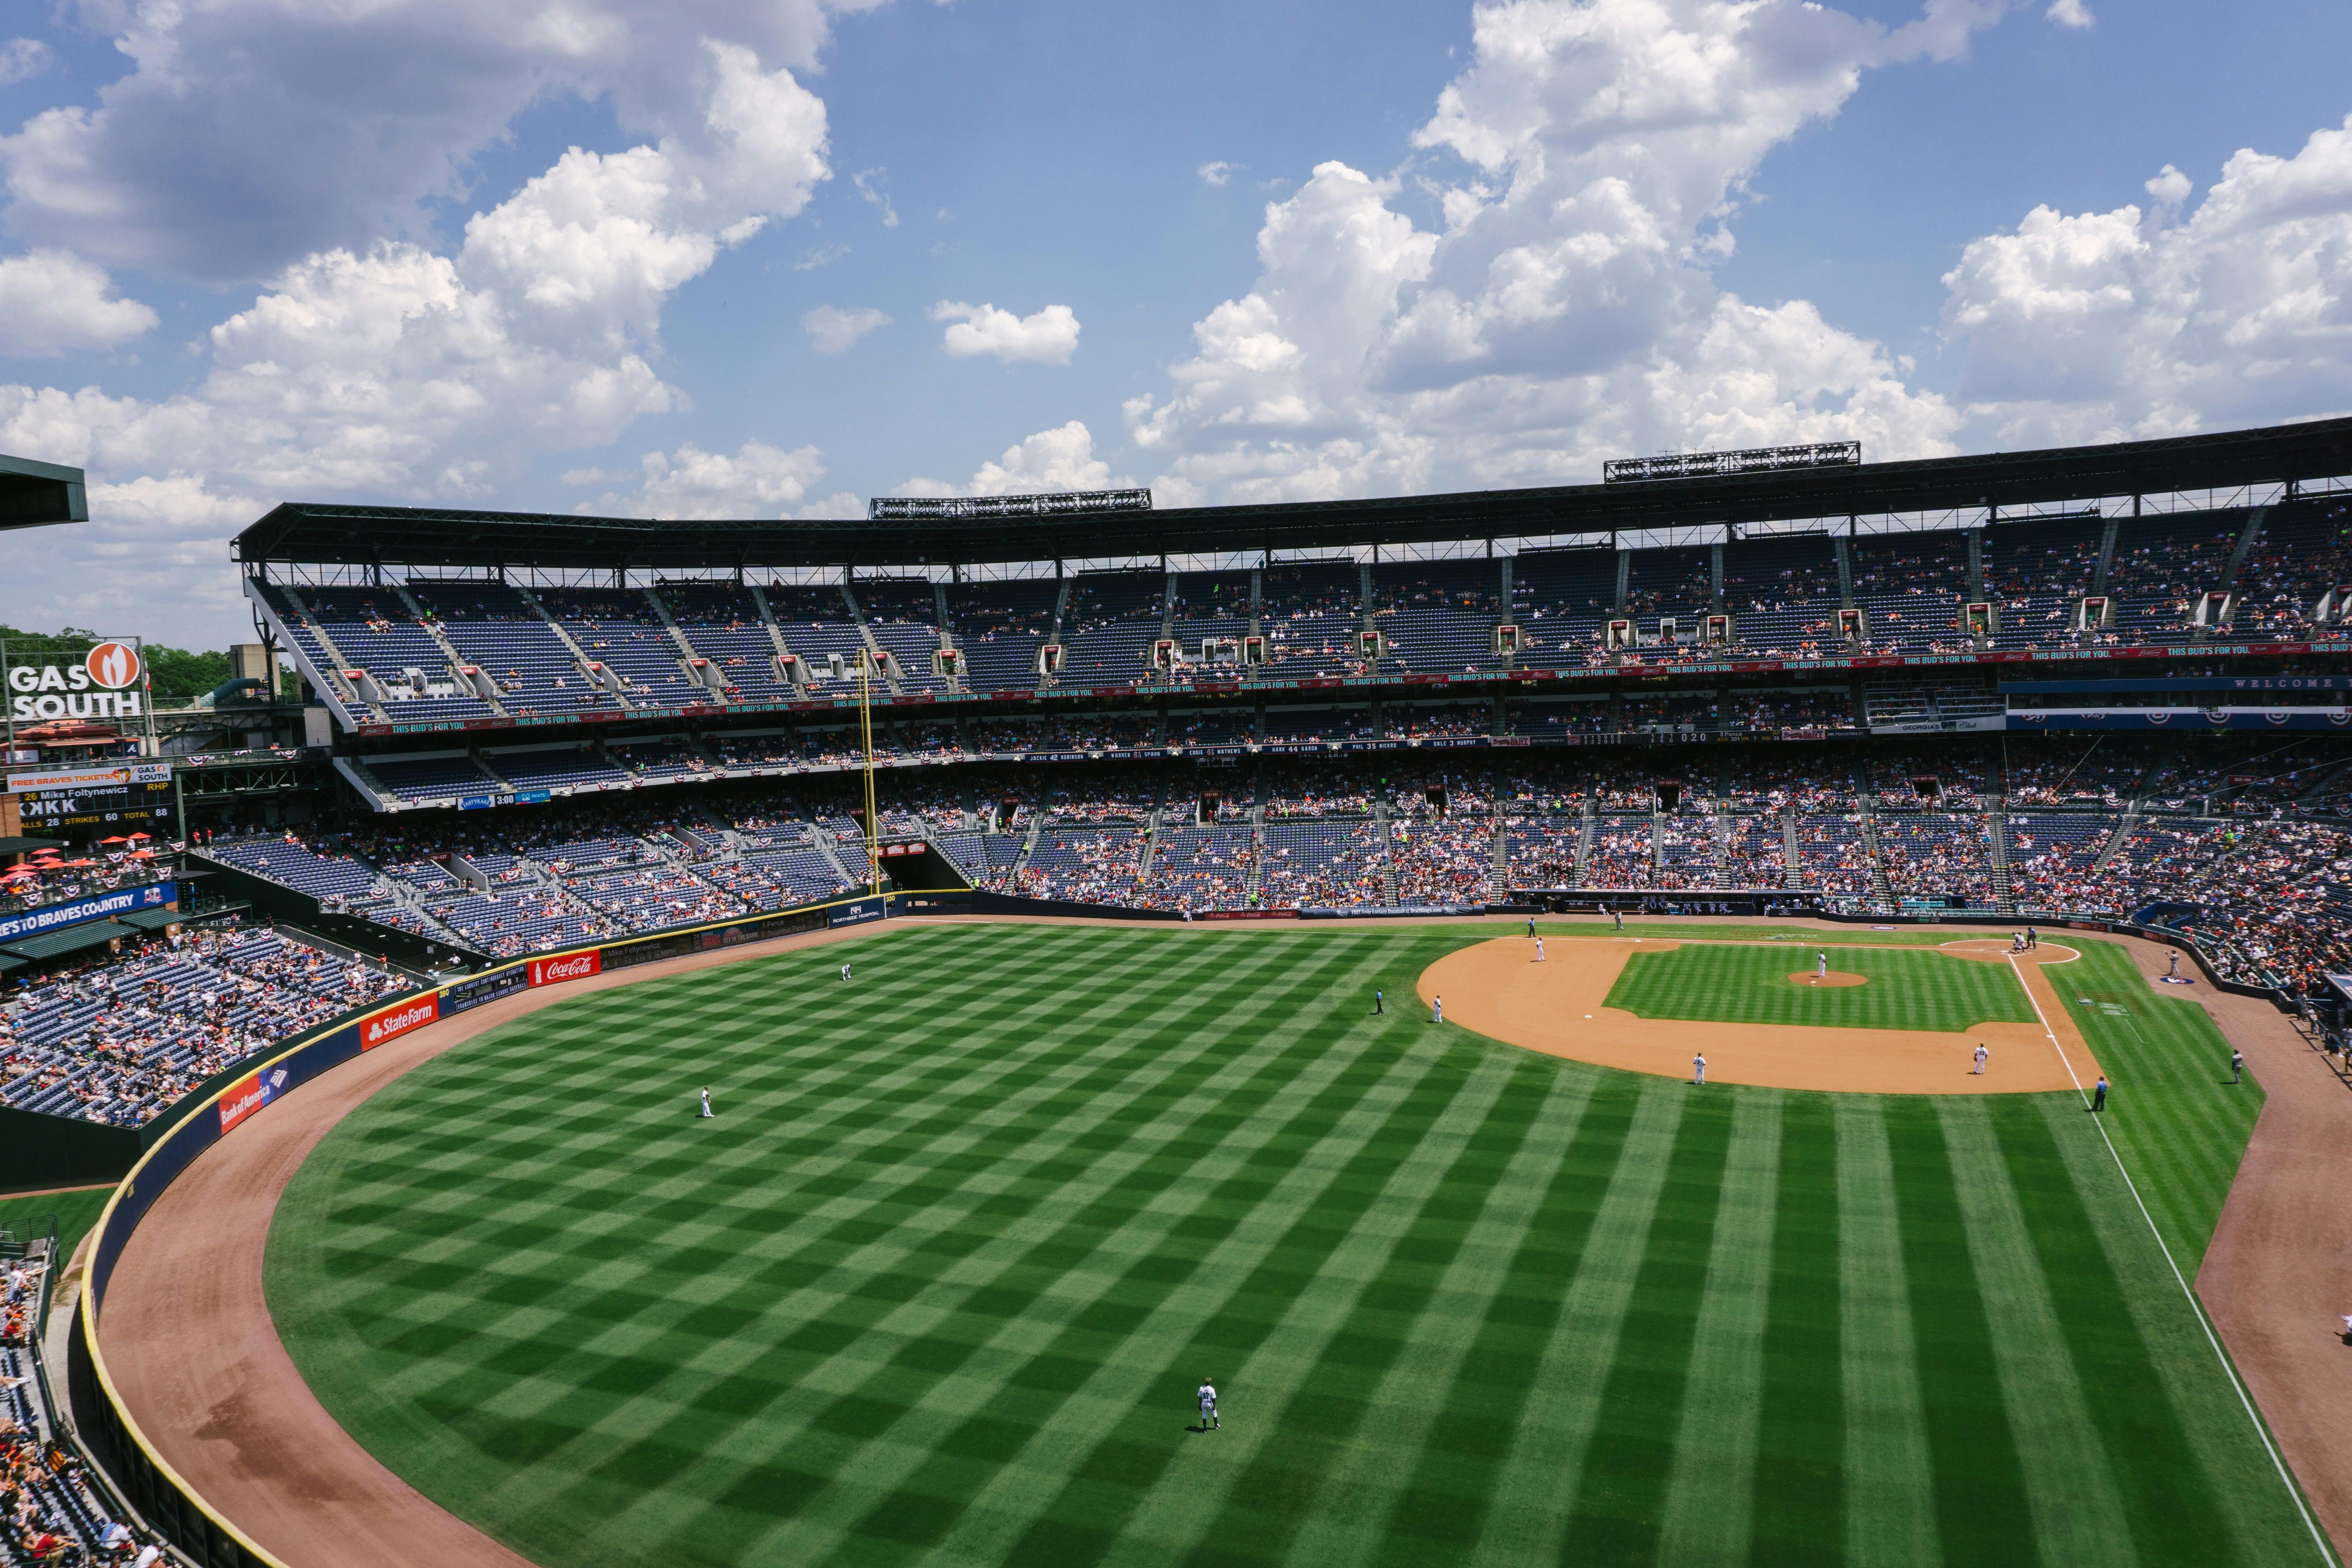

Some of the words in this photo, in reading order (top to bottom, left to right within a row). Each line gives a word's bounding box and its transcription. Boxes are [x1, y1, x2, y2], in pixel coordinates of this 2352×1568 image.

[9, 665, 89, 691] GAS
[2234, 679, 2332, 688] WELCOME
[13, 691, 140, 720] SOUTH
[392, 725, 409, 733] THIS
[410, 723, 433, 732] BUD'S
[1957, 720, 1977, 729] Club
[1700, 733, 1706, 741] 0
[36, 776, 72, 785] BRAVES
[74, 773, 113, 782] TICKETS!
[138, 773, 168, 781] SOUTH
[147, 783, 169, 791] RHP
[41, 791, 65, 800] Mike
[68, 787, 128, 799] Foltynewicz
[462, 798, 490, 808] TASTYKAKE
[497, 795, 514, 805] 3:00
[46, 818, 60, 827] 28
[65, 816, 100, 825] STRIKES
[105, 813, 118, 821] 60
[124, 811, 150, 819] TOTAL
[156, 808, 167, 817] 88
[20, 916, 37, 931] TO
[38, 906, 82, 927] BRAVES
[82, 894, 134, 916] COUNTRY
[608, 949, 623, 957] Mike
[624, 943, 660, 955] Foltynewicz
[661, 948, 676, 956] MPH
[547, 956, 593, 979] Coca-Cola
[465, 980, 479, 990] LONGEST
[481, 972, 505, 985] CONTINUOUSLY
[506, 966, 524, 976] OPERATING
[439, 989, 449, 998] 390
[457, 998, 477, 1009] FRANCHISE
[484, 992, 495, 1001] MAJOR
[496, 988, 509, 996] LEAGUE
[510, 982, 526, 991] BASEBALL
[221, 1105, 238, 1125] Bank
[237, 1098, 245, 1114] of
[244, 1085, 270, 1109] America
